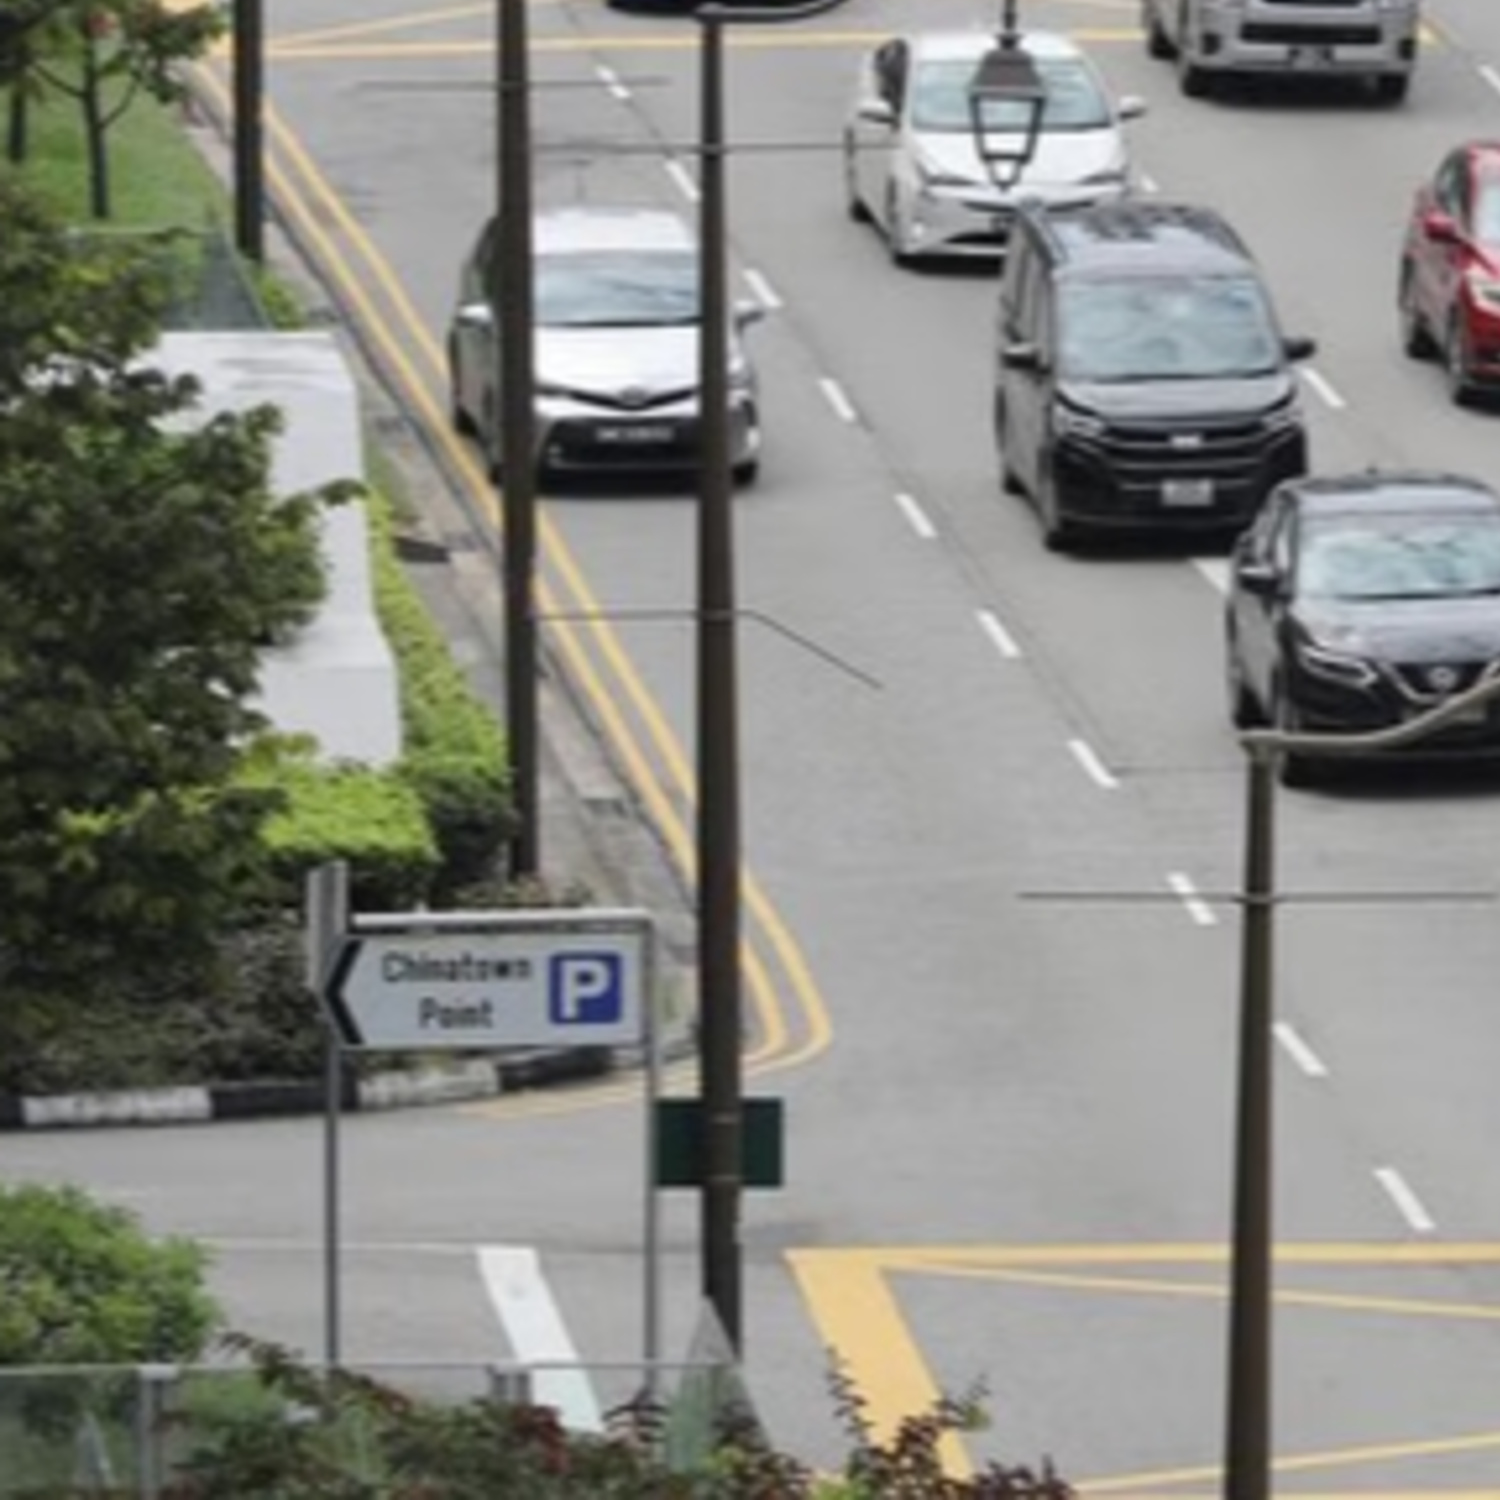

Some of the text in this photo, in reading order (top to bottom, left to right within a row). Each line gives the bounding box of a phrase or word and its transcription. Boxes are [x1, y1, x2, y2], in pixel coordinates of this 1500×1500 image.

[382, 953, 532, 984] Chinatown
[560, 957, 611, 1019] P
[418, 998, 494, 1030] Point
